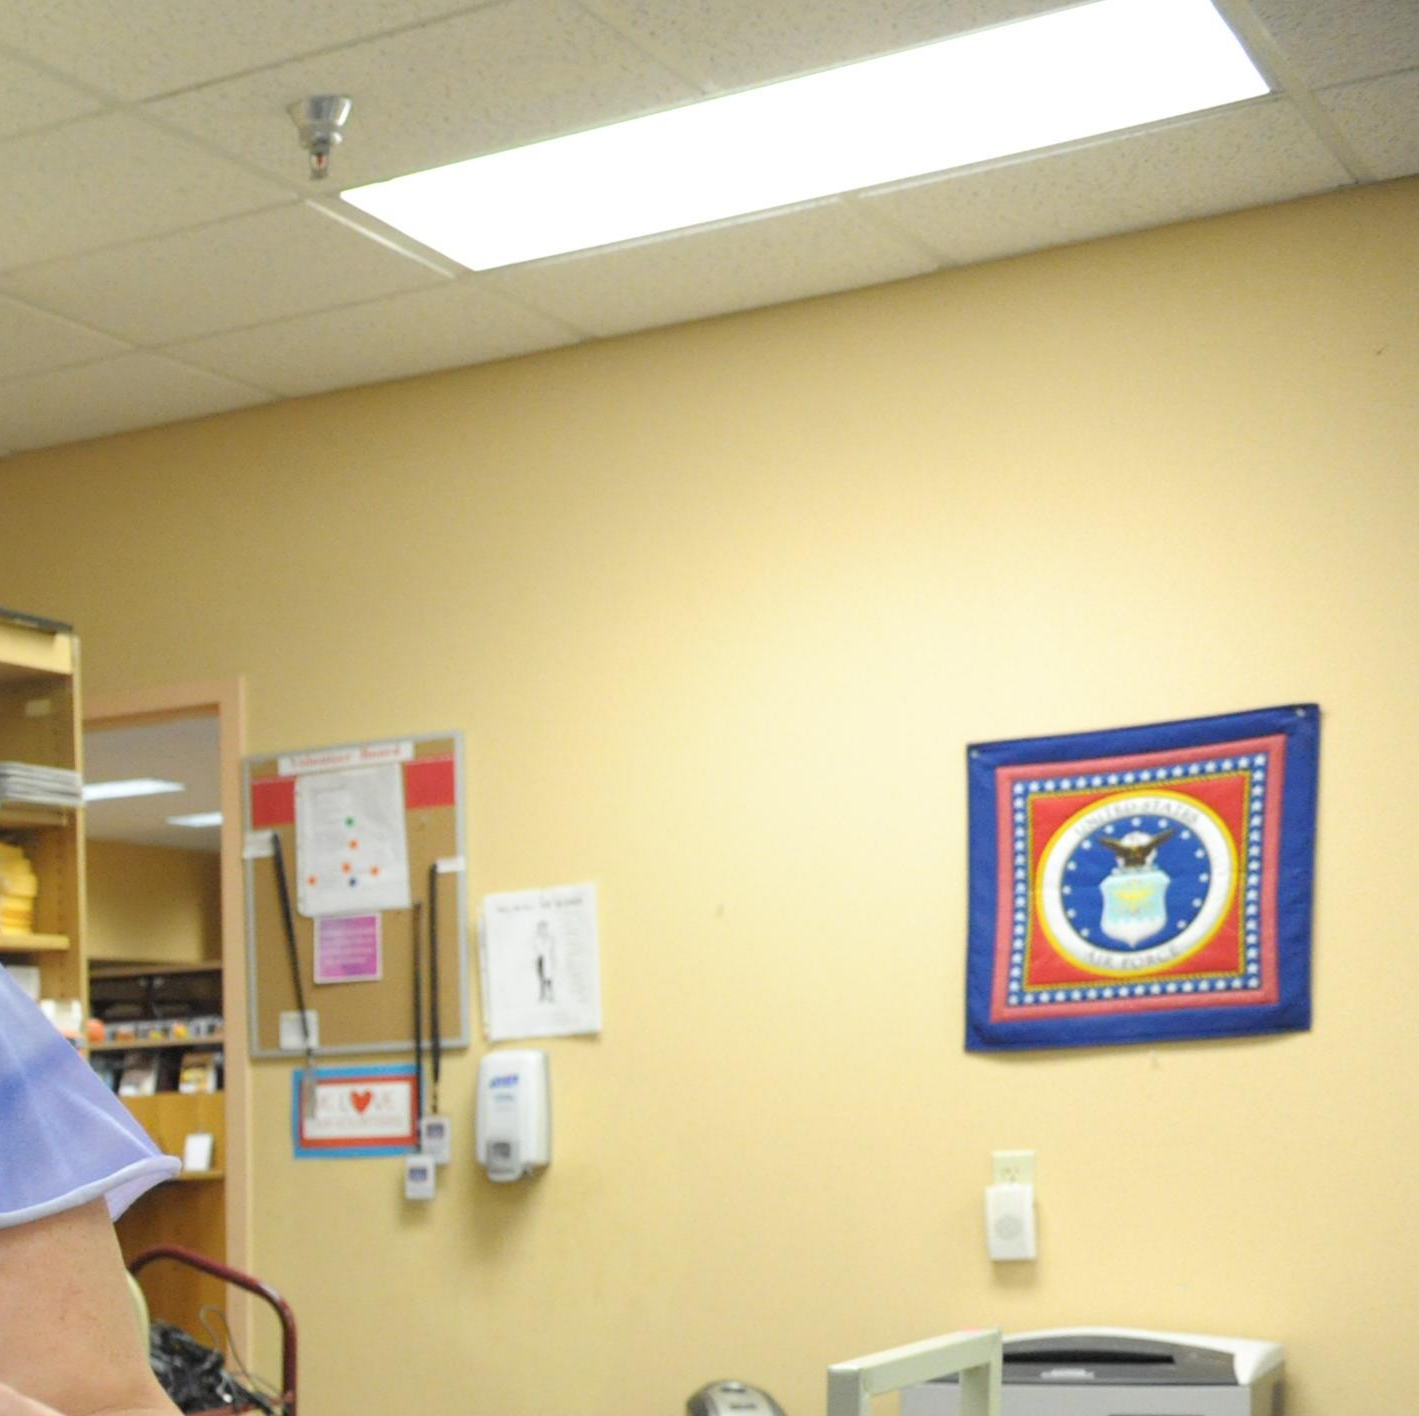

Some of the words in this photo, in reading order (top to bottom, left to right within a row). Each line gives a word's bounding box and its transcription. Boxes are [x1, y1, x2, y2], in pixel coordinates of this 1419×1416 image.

[361, 743, 403, 762] Board
[1136, 801, 1198, 824] STATES
[1121, 945, 1180, 968] FORCE
